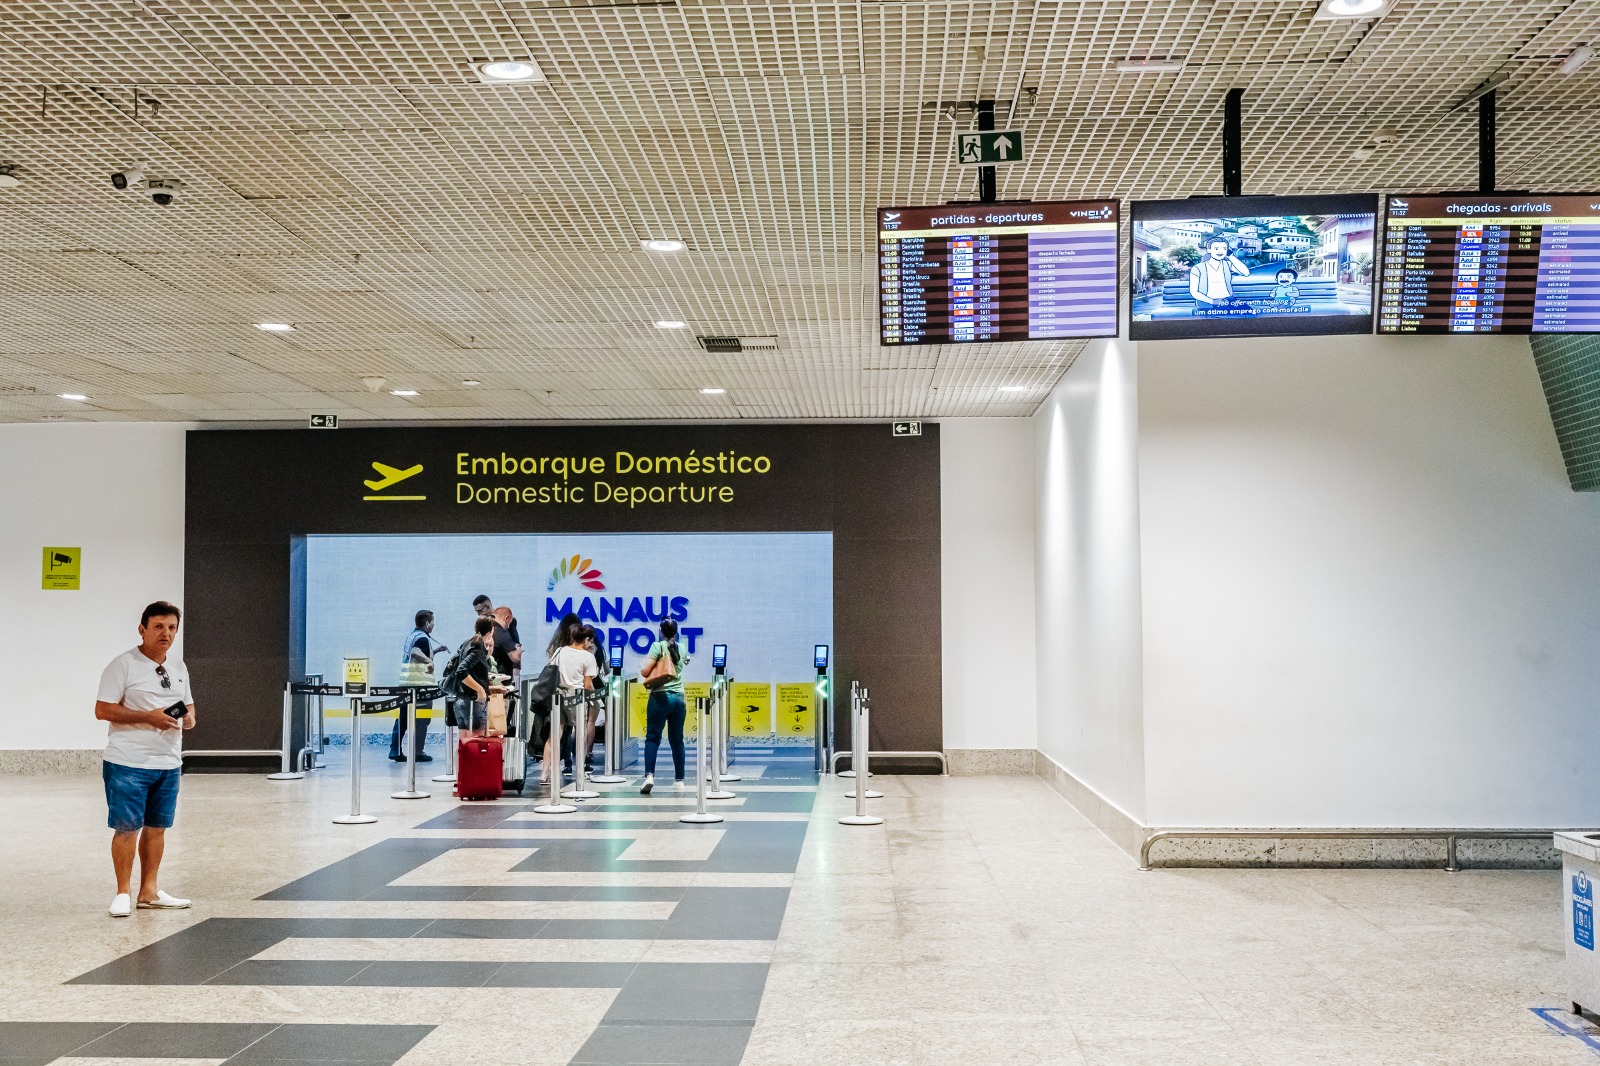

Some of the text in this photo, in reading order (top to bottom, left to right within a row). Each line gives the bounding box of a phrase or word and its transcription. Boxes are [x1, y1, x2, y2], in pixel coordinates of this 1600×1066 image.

[931, 214, 976, 227] partidas
[985, 213, 1044, 224] departures
[1446, 204, 1500, 214] chegadas
[1510, 202, 1552, 212] arrivals
[456, 449, 772, 480] Embarque Doméstico
[456, 481, 734, 508] Domestic Departure
[546, 596, 689, 622] MANAUS
